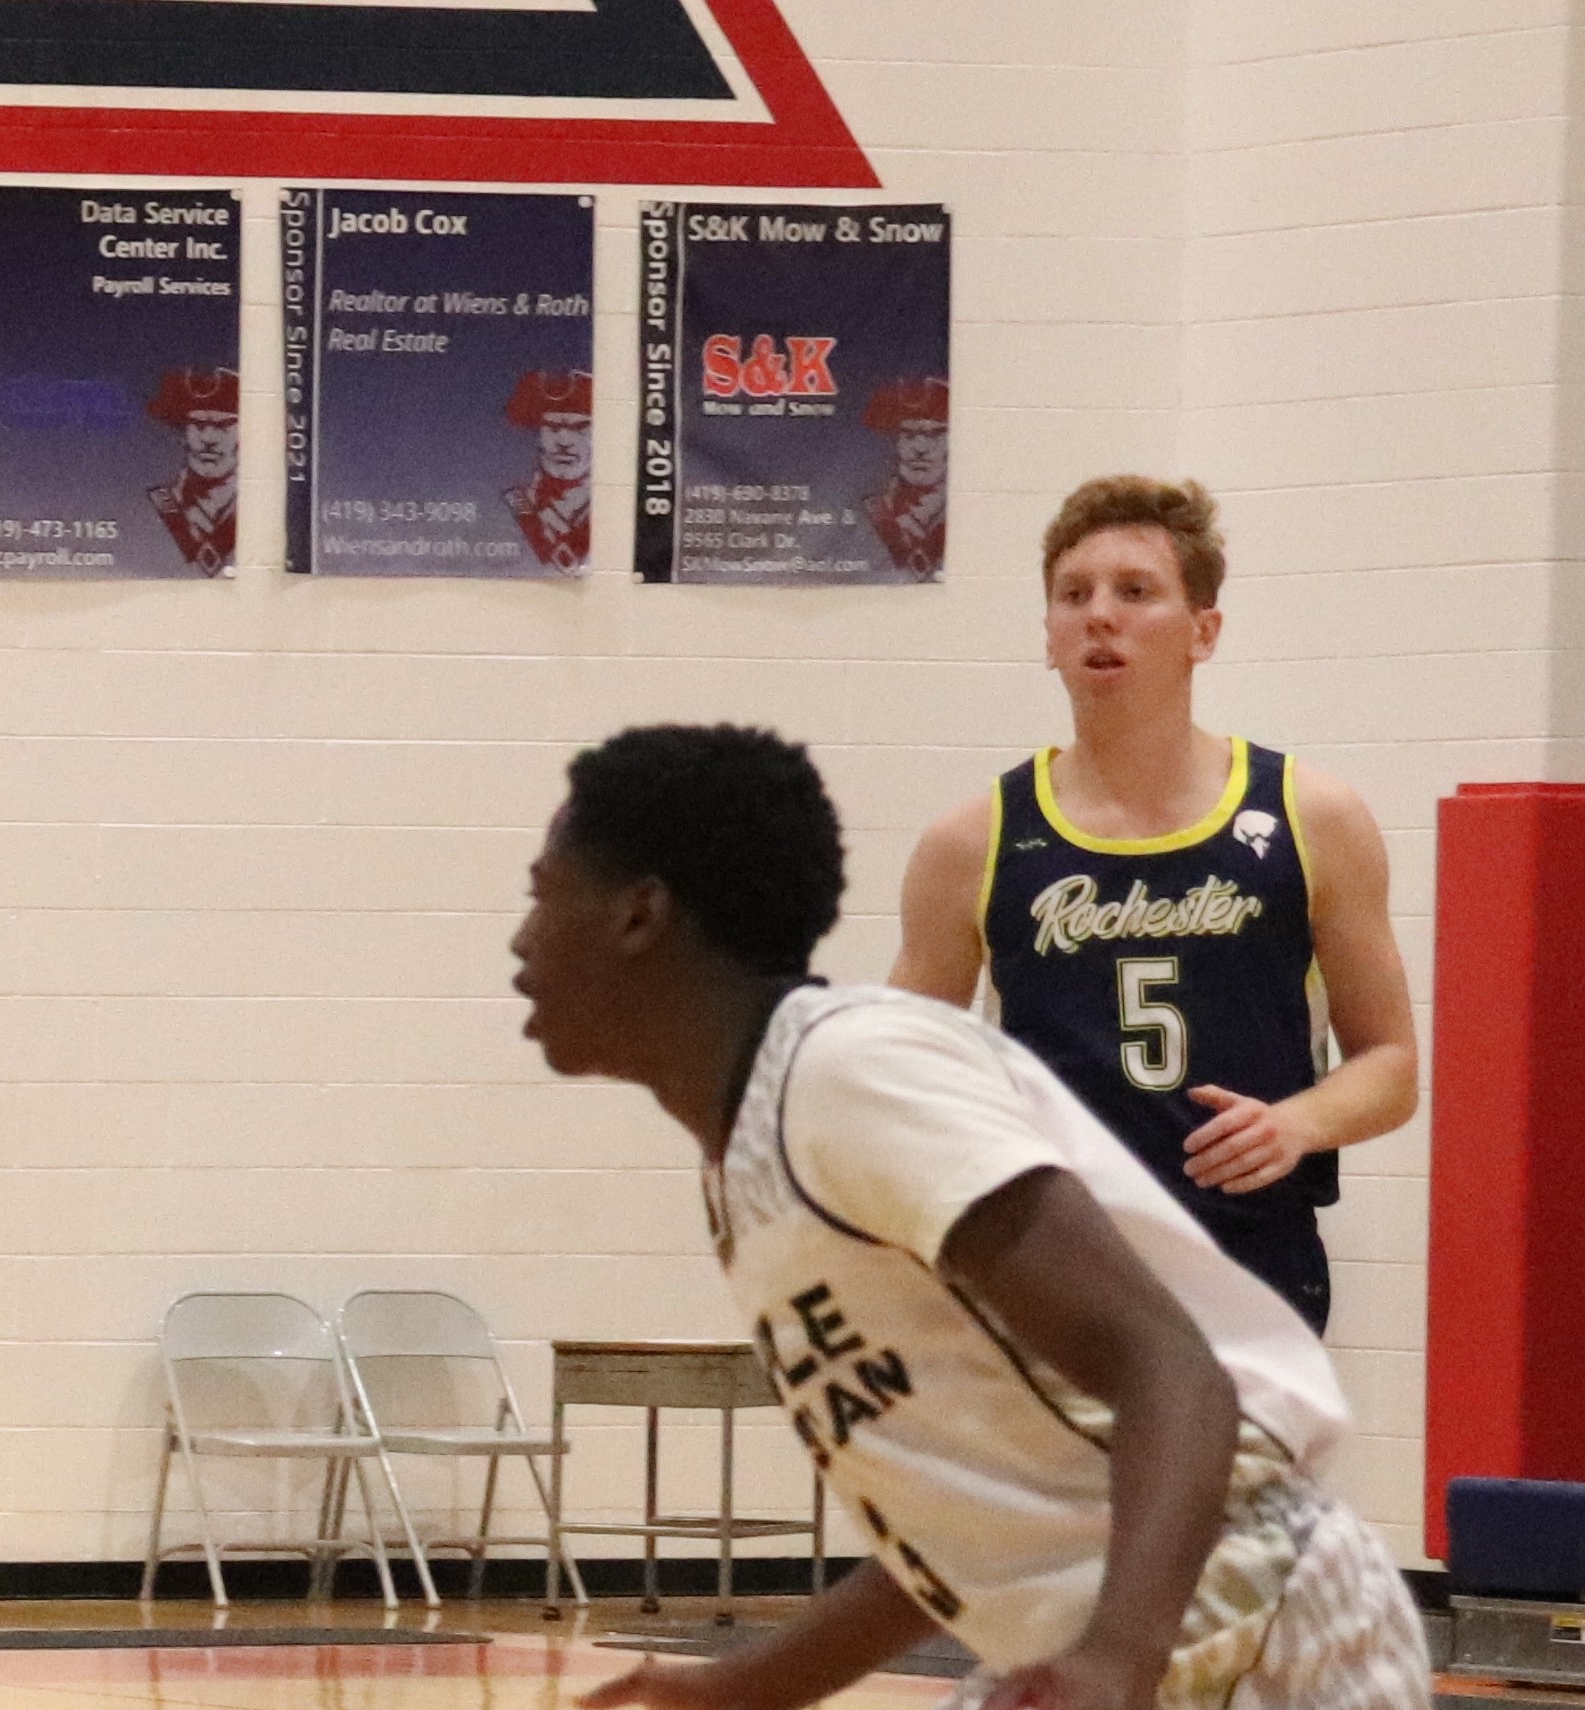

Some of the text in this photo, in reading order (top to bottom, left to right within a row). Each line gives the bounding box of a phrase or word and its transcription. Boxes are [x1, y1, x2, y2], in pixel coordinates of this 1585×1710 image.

[81, 201, 229, 227] Data Service
[328, 208, 467, 238] Jacob Cox
[688, 215, 944, 243] S&K Mow & Snow
[99, 236, 227, 260] Center Inc.
[93, 276, 231, 299] Payroll Services
[329, 290, 590, 317] Realtor at Wiens & Roth
[282, 191, 309, 483] Sponsor Since 2021
[329, 329, 449, 354] Real Estate
[644, 203, 674, 517] Sponsor Since 2018
[702, 333, 839, 397] S&K
[1031, 874, 1261, 957] Rochester
[1116, 956, 1189, 1091] 5
